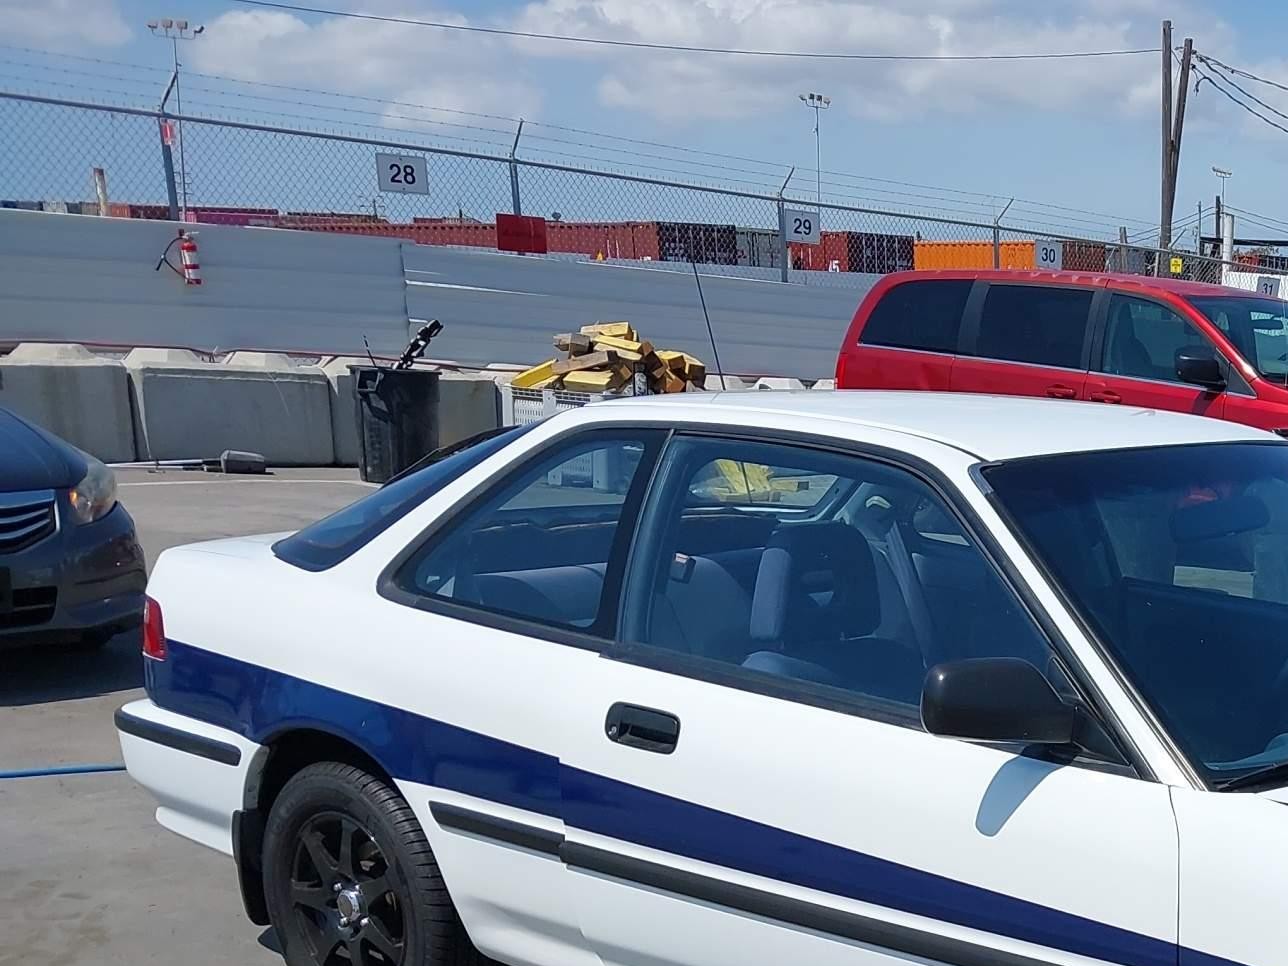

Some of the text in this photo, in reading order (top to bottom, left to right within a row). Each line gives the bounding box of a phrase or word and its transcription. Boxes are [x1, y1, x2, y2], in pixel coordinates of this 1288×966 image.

[389, 163, 416, 184] 28
[793, 217, 812, 236] 29
[1041, 247, 1056, 263] 30
[1262, 282, 1274, 295] 31
